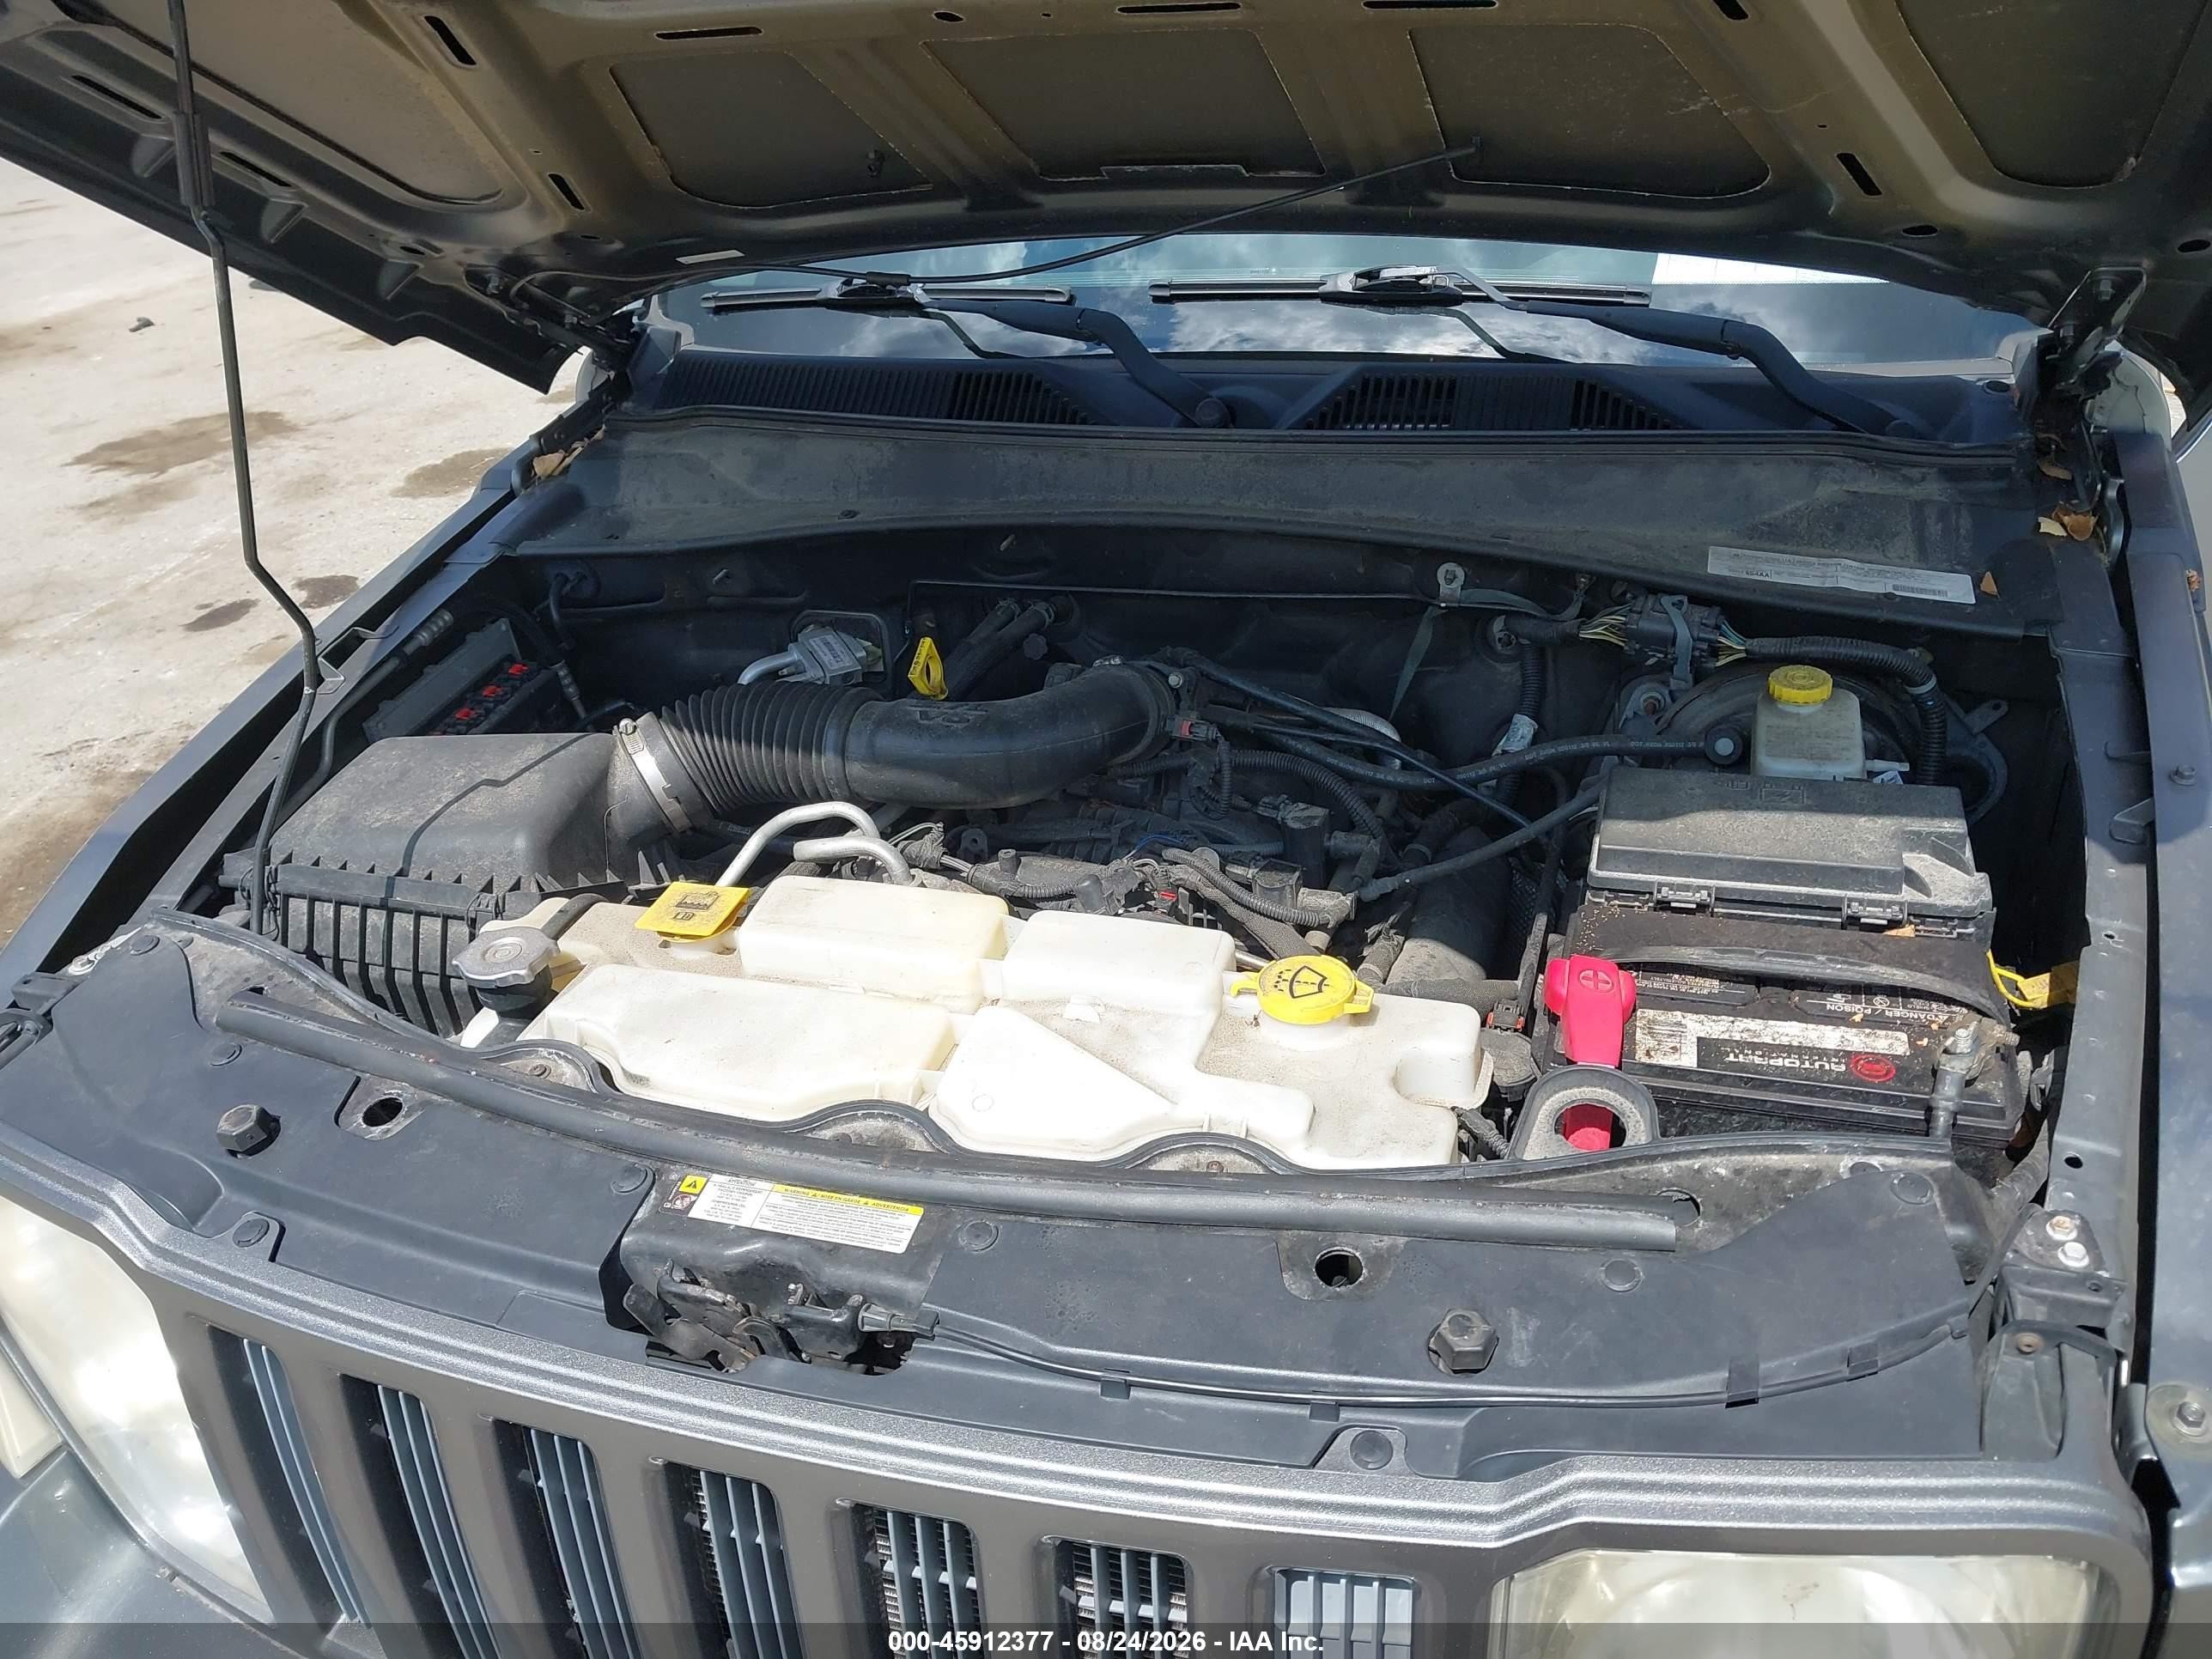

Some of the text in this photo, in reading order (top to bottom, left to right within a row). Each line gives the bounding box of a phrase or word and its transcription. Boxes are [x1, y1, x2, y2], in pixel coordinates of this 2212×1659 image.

[1826, 1003, 1872, 1015] POISON
[1885, 1009, 1936, 1021] DANGER
[1724, 1053, 1846, 1072] AUTOPART
[784, 1188, 810, 1196] WARNING
